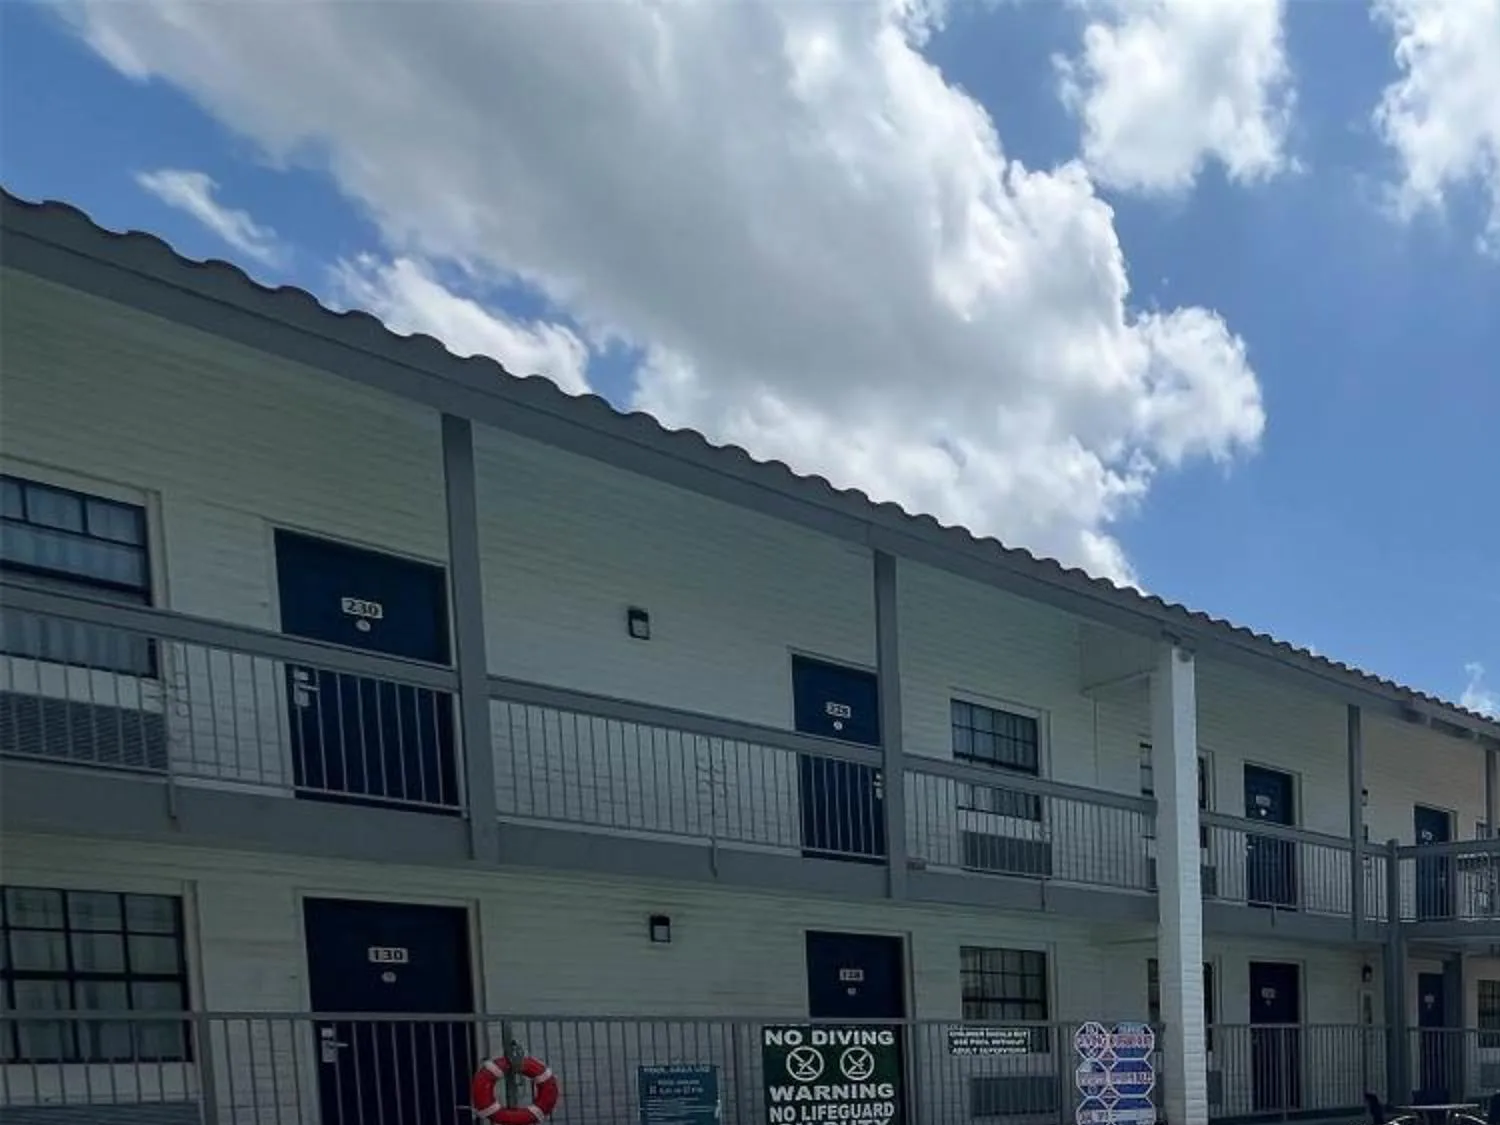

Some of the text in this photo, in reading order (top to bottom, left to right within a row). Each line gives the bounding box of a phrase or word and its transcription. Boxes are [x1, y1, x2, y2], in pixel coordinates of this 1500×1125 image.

[765, 1029, 895, 1046] NO DIVING
[769, 1083, 895, 1102] WARNING
[769, 1102, 895, 1123] NO LIFEGUARD
